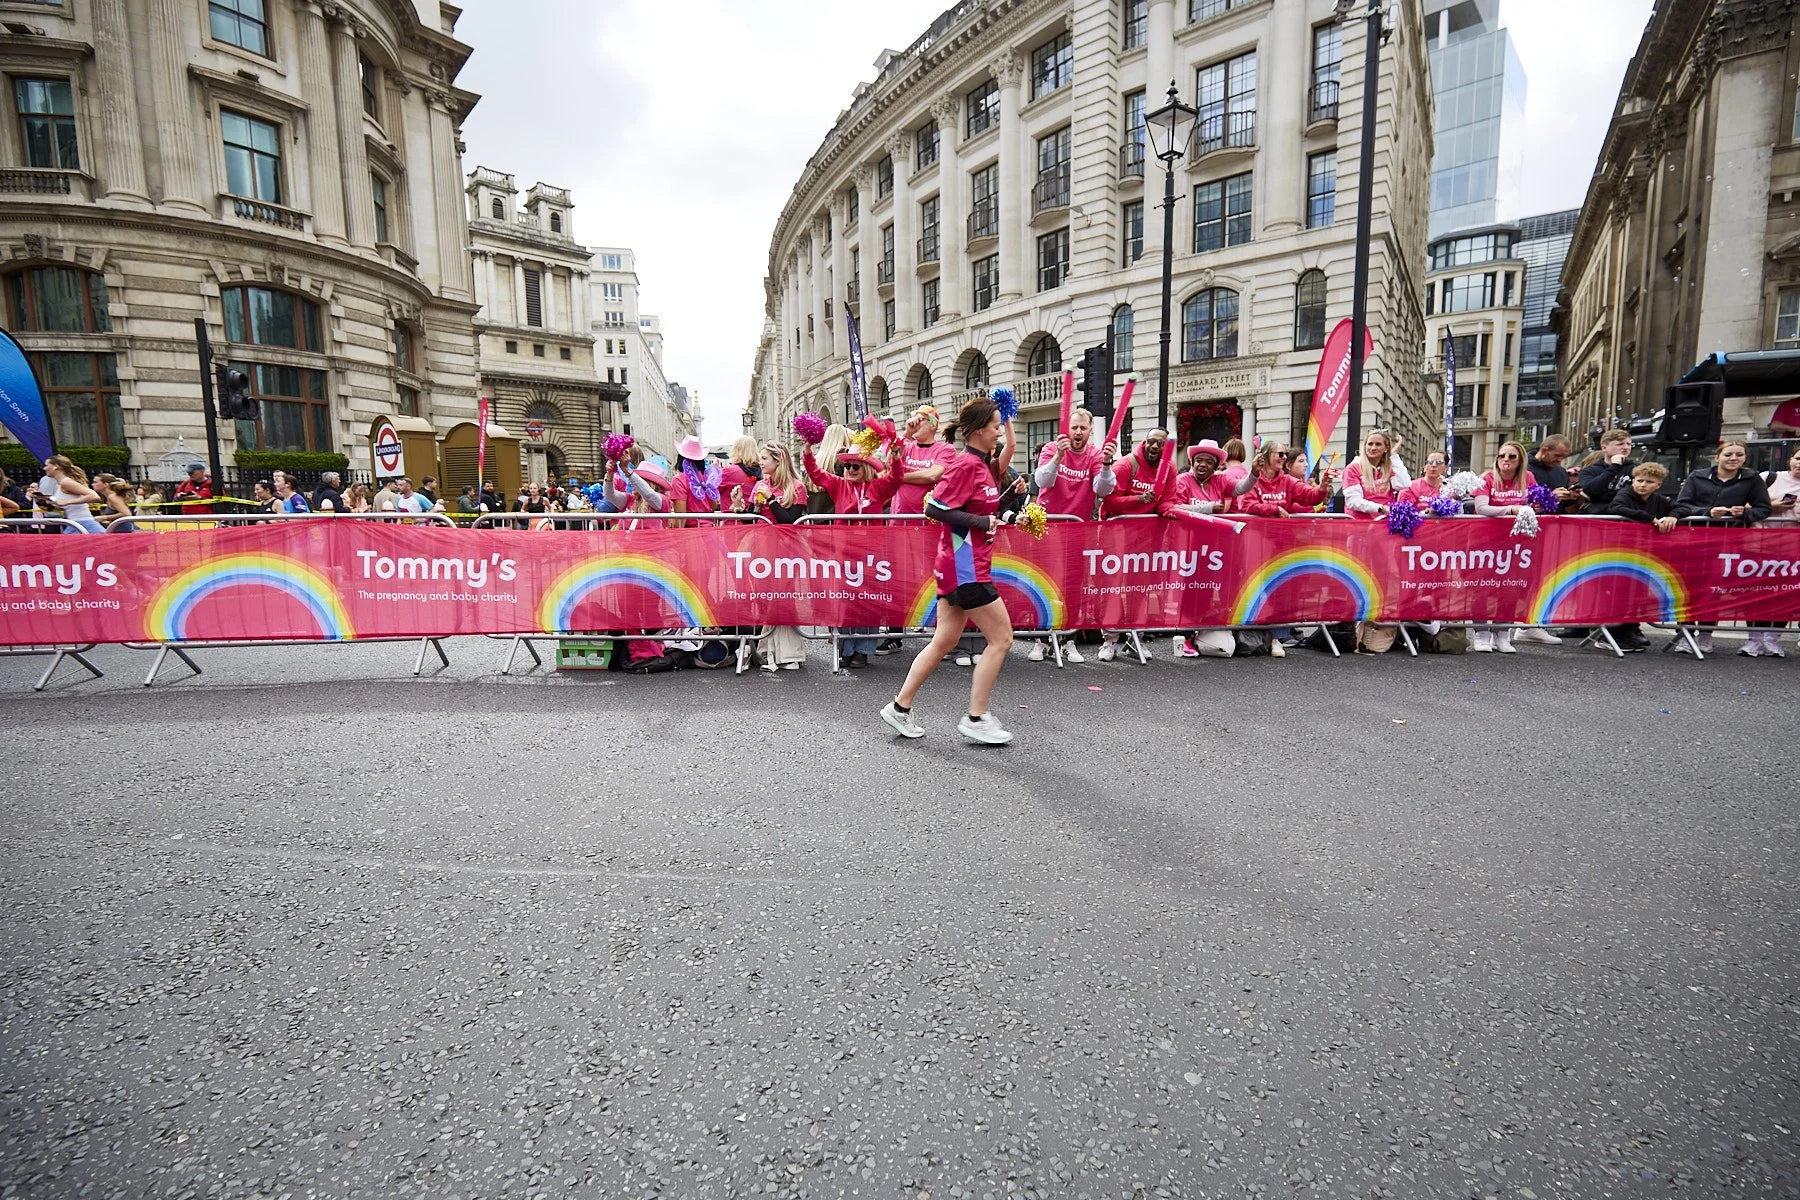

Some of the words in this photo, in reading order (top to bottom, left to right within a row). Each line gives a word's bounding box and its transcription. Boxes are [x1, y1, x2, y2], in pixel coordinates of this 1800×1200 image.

[1176, 378, 1217, 388] LOMBARD
[1220, 373, 1251, 384] STREET
[9, 402, 30, 423] Smith
[376, 444, 401, 454] UNDERGROUND
[1082, 544, 1224, 577] Tommy's
[1401, 543, 1533, 575] Tommy's
[0, 557, 118, 595] my's
[356, 550, 517, 588] Tommy's
[727, 551, 892, 588] Tommy's
[1083, 586, 1099, 595] The
[1100, 583, 1146, 597] pregnancy
[1147, 581, 1164, 592] and
[1165, 581, 1187, 591] baby
[1188, 580, 1222, 592] charity
[1401, 580, 1417, 590] The
[1418, 580, 1462, 590] pregnancy
[1463, 579, 1480, 588] and
[1480, 578, 1501, 589] baby
[1502, 577, 1528, 589] charity
[11, 600, 36, 610] and
[38, 600, 72, 612] baby
[74, 598, 121, 611] charity
[358, 590, 375, 600] The
[376, 592, 427, 602] pregnancy
[429, 591, 449, 601] and
[451, 591, 478, 603] baby
[480, 592, 518, 604] charity
[727, 590, 747, 600] The
[750, 591, 804, 601] pregnancy
[806, 590, 826, 599] and
[829, 590, 855, 600] baby
[858, 590, 893, 603] charity
